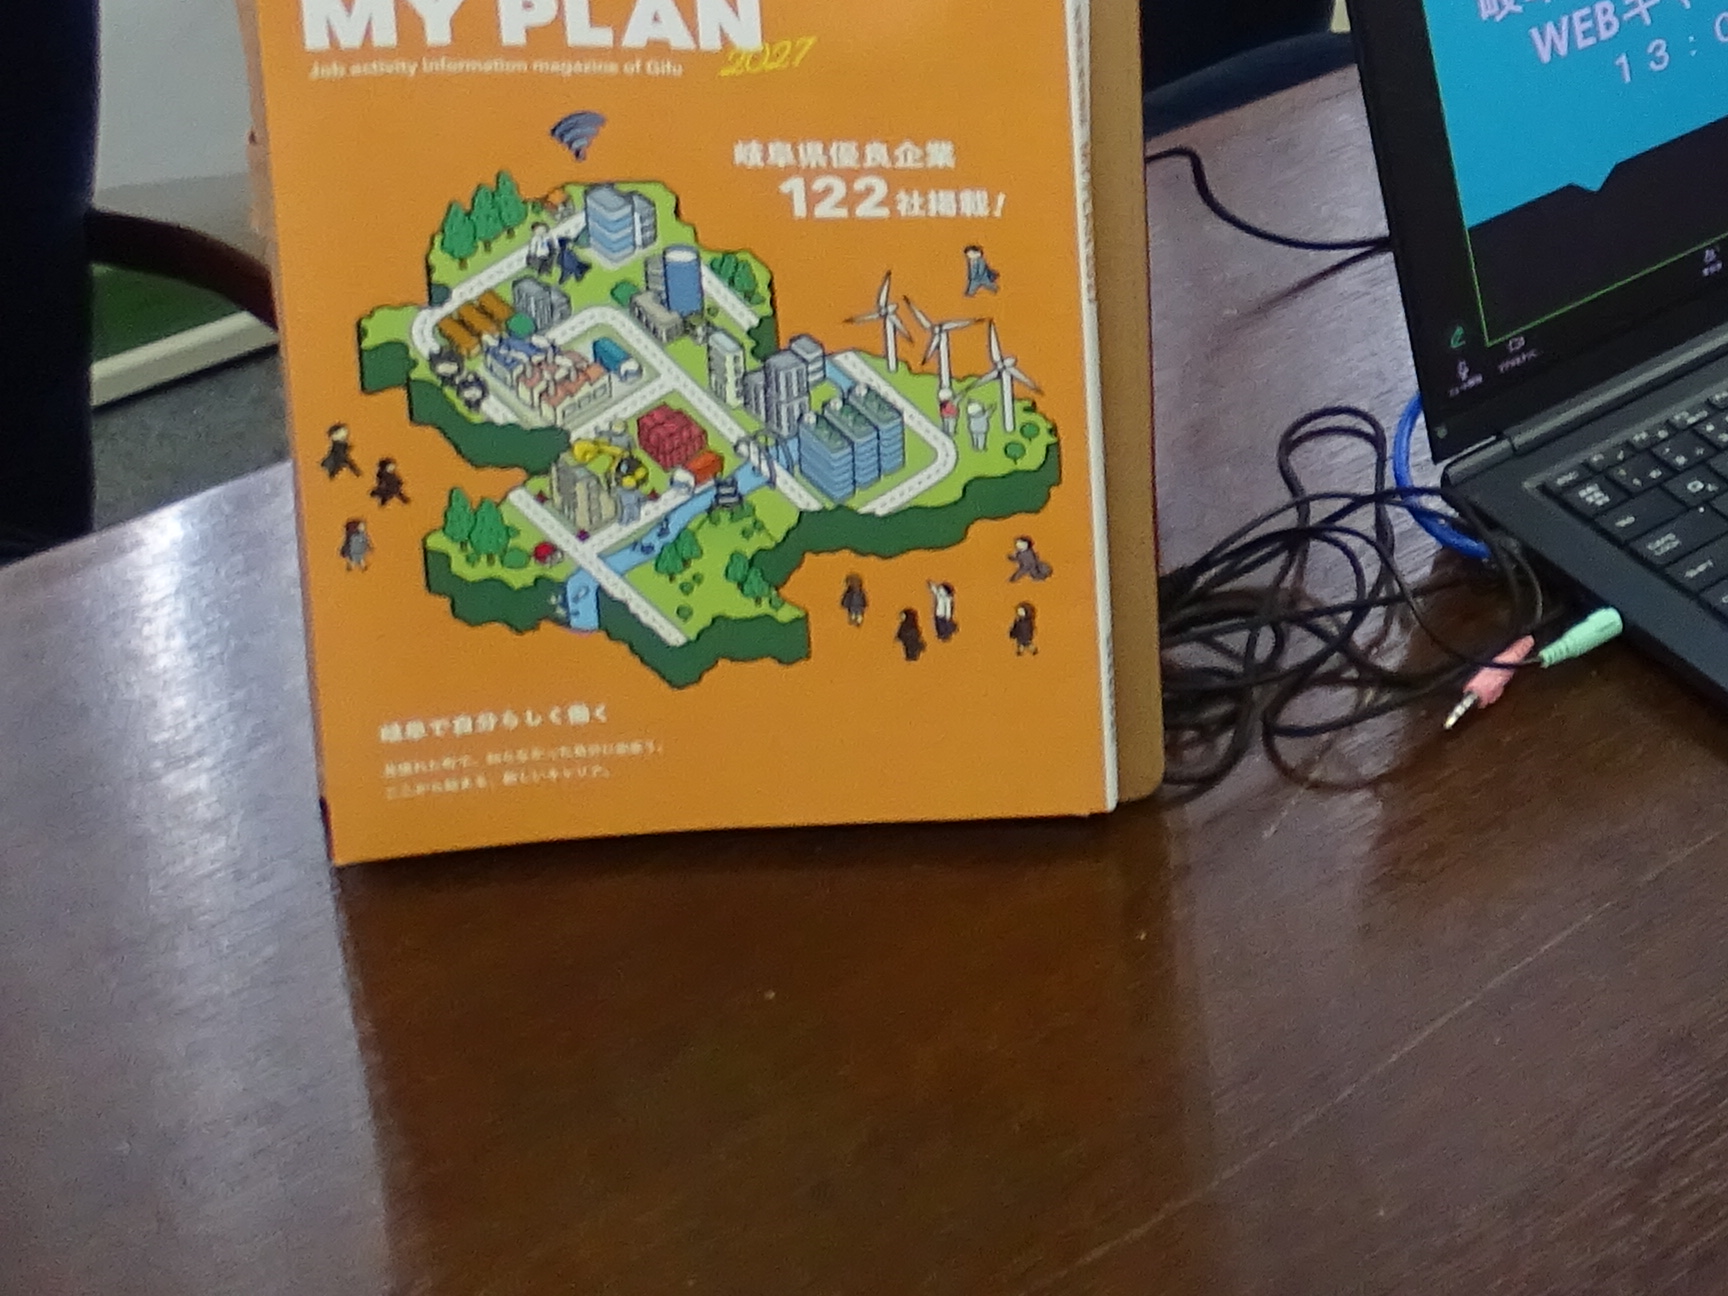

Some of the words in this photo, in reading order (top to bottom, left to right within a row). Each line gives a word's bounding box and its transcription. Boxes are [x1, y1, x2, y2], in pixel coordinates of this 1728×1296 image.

[422, 57, 529, 75] information
[532, 59, 619, 78] magazine
[623, 58, 643, 75] of
[718, 36, 818, 77] 2027
